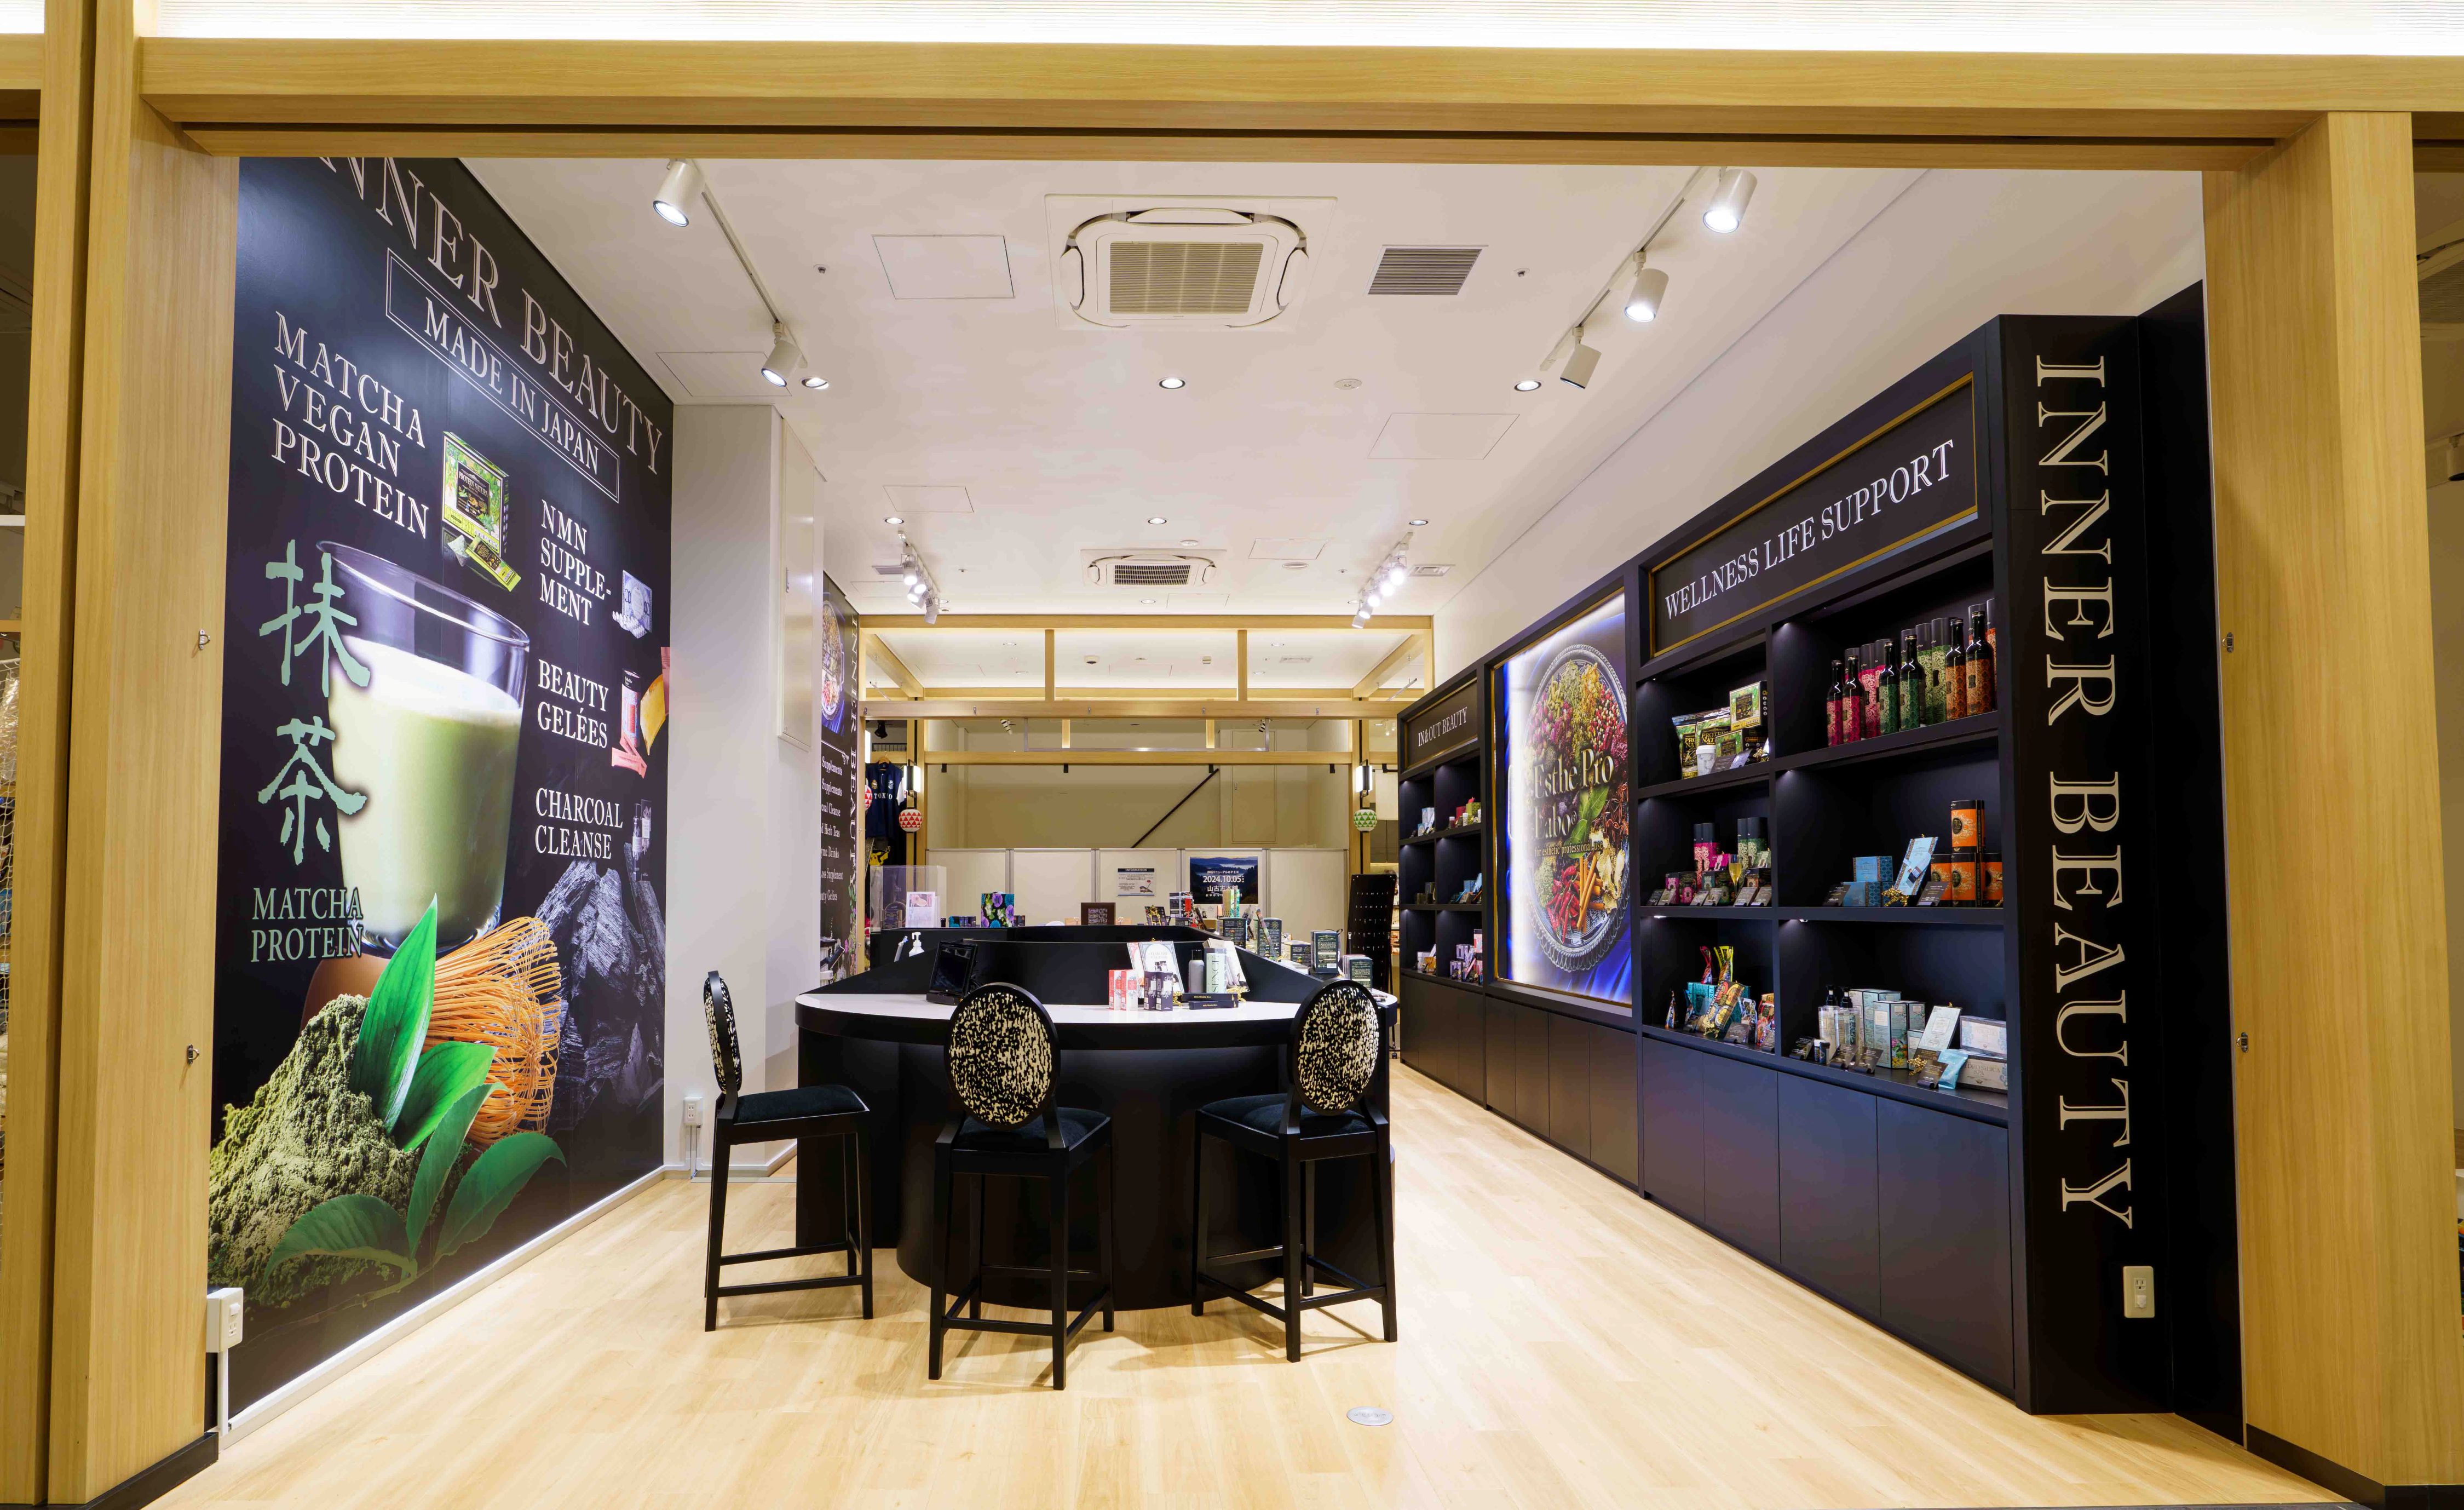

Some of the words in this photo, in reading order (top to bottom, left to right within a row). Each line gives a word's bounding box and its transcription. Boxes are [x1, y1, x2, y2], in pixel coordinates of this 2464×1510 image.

[274, 311, 425, 449] MATCHA
[424, 297, 502, 395] MADE
[510, 372, 534, 422] IN
[543, 399, 598, 475] JAPAN
[520, 289, 662, 475] BEAUTY
[273, 364, 400, 478] VEGAN
[271, 418, 429, 539] PROTEIN
[541, 499, 588, 555] NMN
[1665, 548, 1759, 620] WELLNESS
[1764, 516, 1816, 571] LIFE
[1821, 439, 1954, 541] SUPPORT
[2036, 354, 2117, 726] INNER
[540, 537, 612, 599] SUPPLE-
[539, 573, 592, 626] MENT
[258, 539, 371, 865] 抹茶
[538, 659, 609, 712] BEAUTY
[537, 701, 608, 749] GELÉES
[1418, 721, 1441, 747] IN&OUT
[1442, 707, 1467, 735] BEAUTY
[1534, 753, 1578, 799] Esthe
[1582, 746, 1614, 788] Pro
[535, 788, 624, 829] CHARCOAL
[534, 826, 612, 860] CLEANSE
[1542, 844, 1560, 857] esthetic
[1561, 841, 1593, 857] professional
[1594, 841, 1603, 850] use
[251, 887, 363, 921] MATCHA
[250, 925, 363, 963] PROTEIN
[2050, 771, 2133, 1230] BEAUTY
